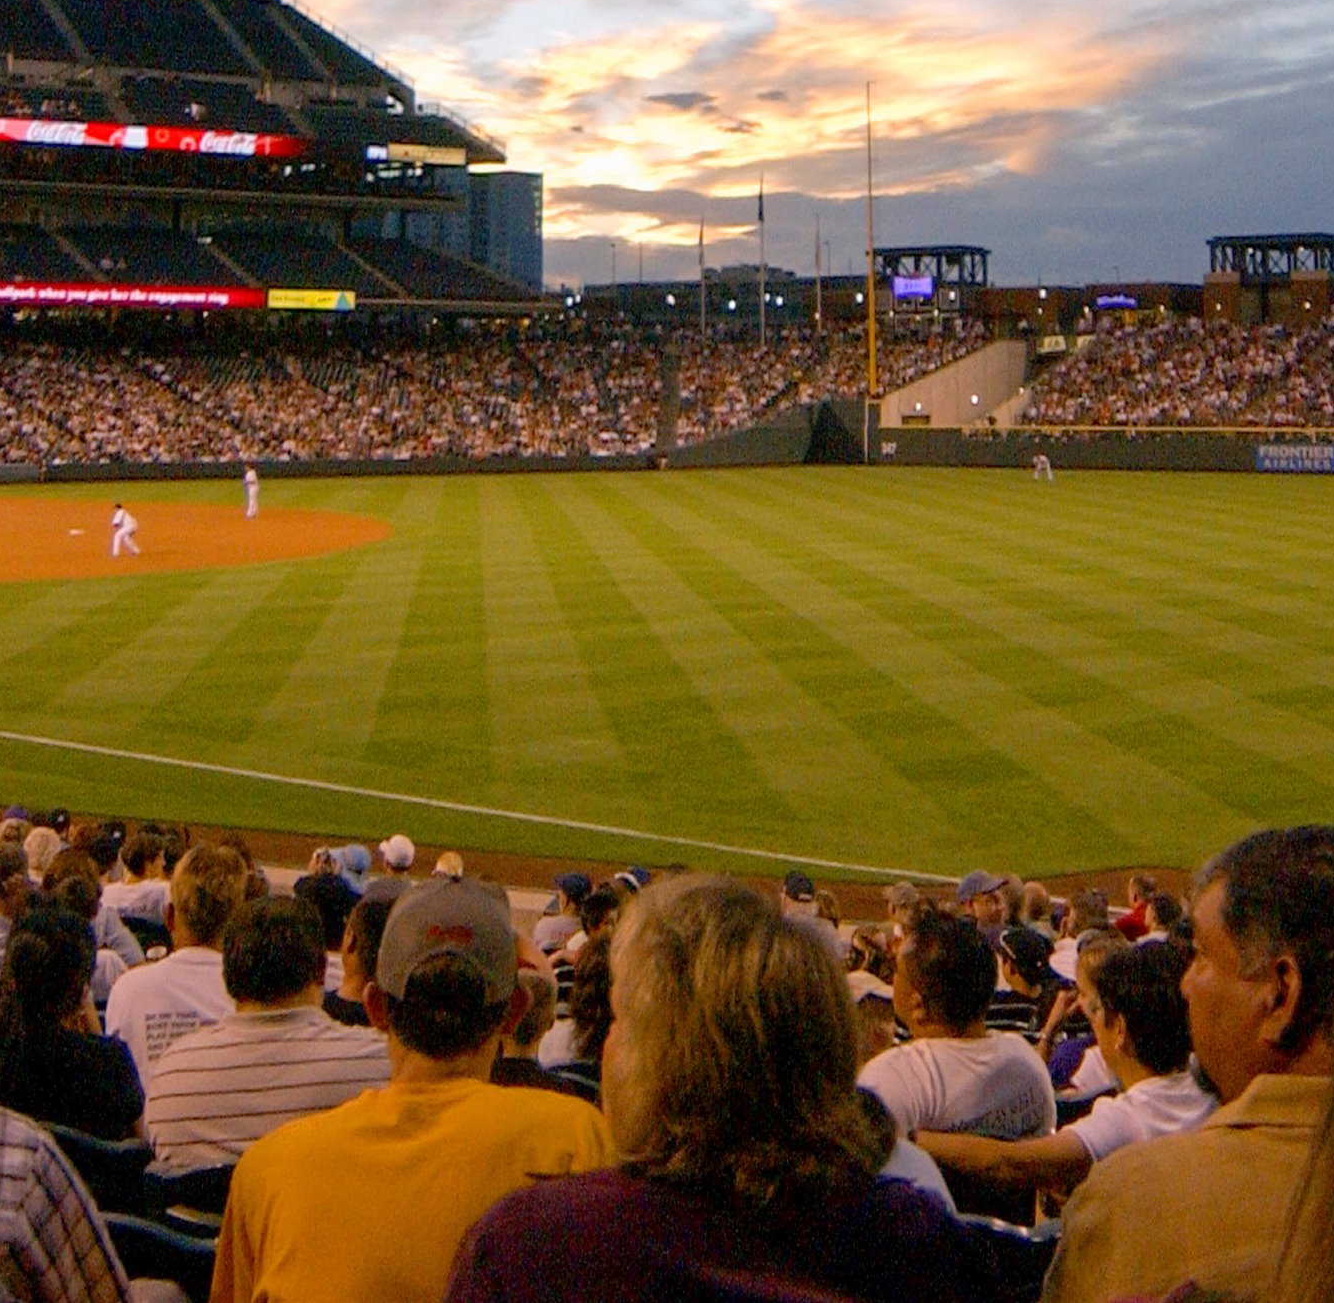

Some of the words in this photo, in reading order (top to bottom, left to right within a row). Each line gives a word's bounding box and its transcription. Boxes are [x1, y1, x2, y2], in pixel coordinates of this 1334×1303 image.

[37, 286, 66, 300] when
[129, 288, 147, 302] the
[1258, 443, 1334, 459] FRONTIER
